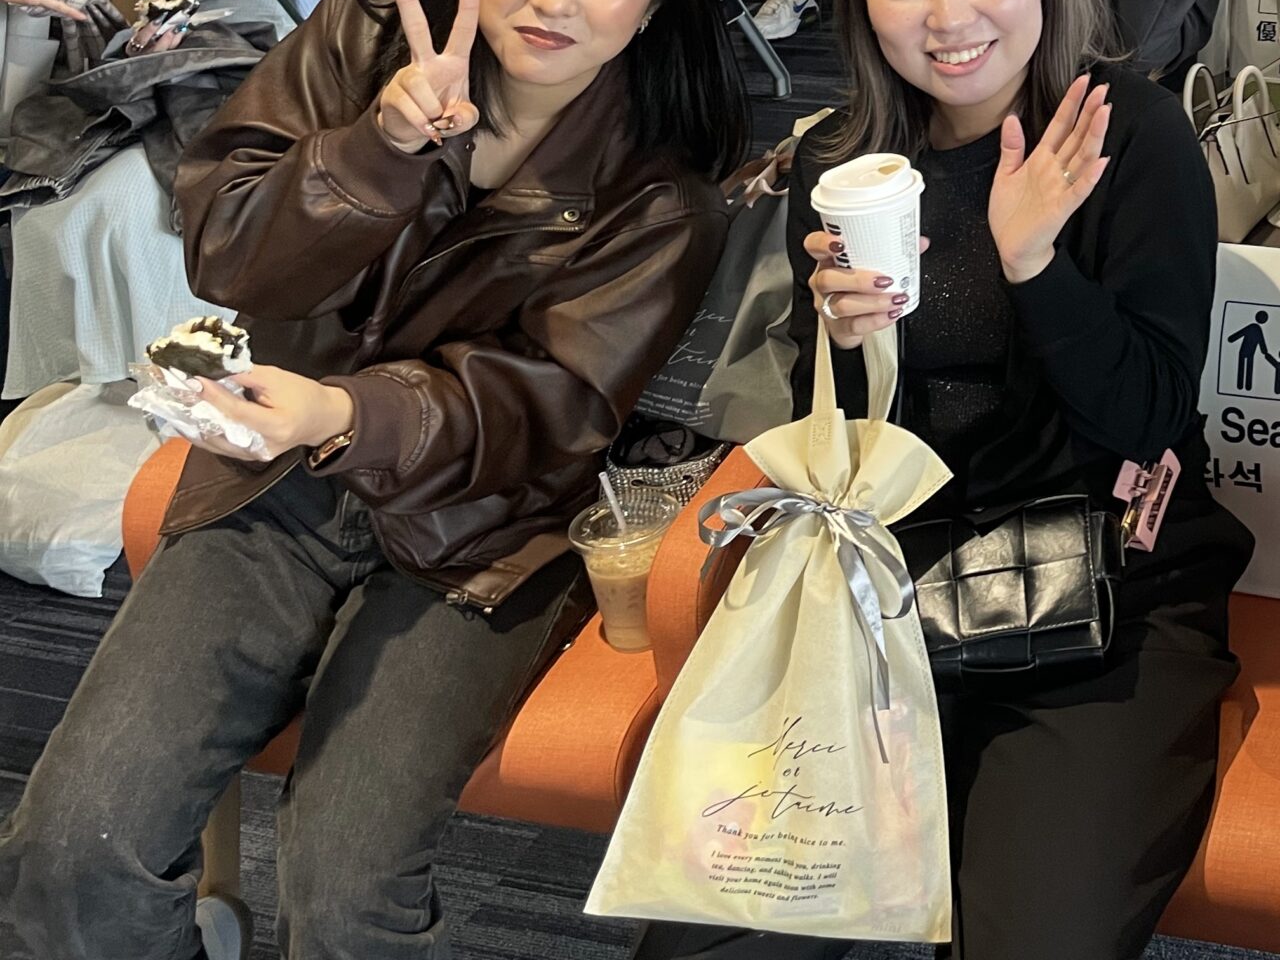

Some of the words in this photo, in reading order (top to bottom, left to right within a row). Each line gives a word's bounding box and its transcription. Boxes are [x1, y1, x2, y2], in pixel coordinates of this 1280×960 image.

[717, 824, 742, 836] Thank
[760, 833, 775, 841] for
[777, 832, 798, 844] being
[800, 837, 816, 846] nice
[716, 851, 731, 859] love
[733, 855, 753, 863] every
[811, 862, 841, 870] drinking
